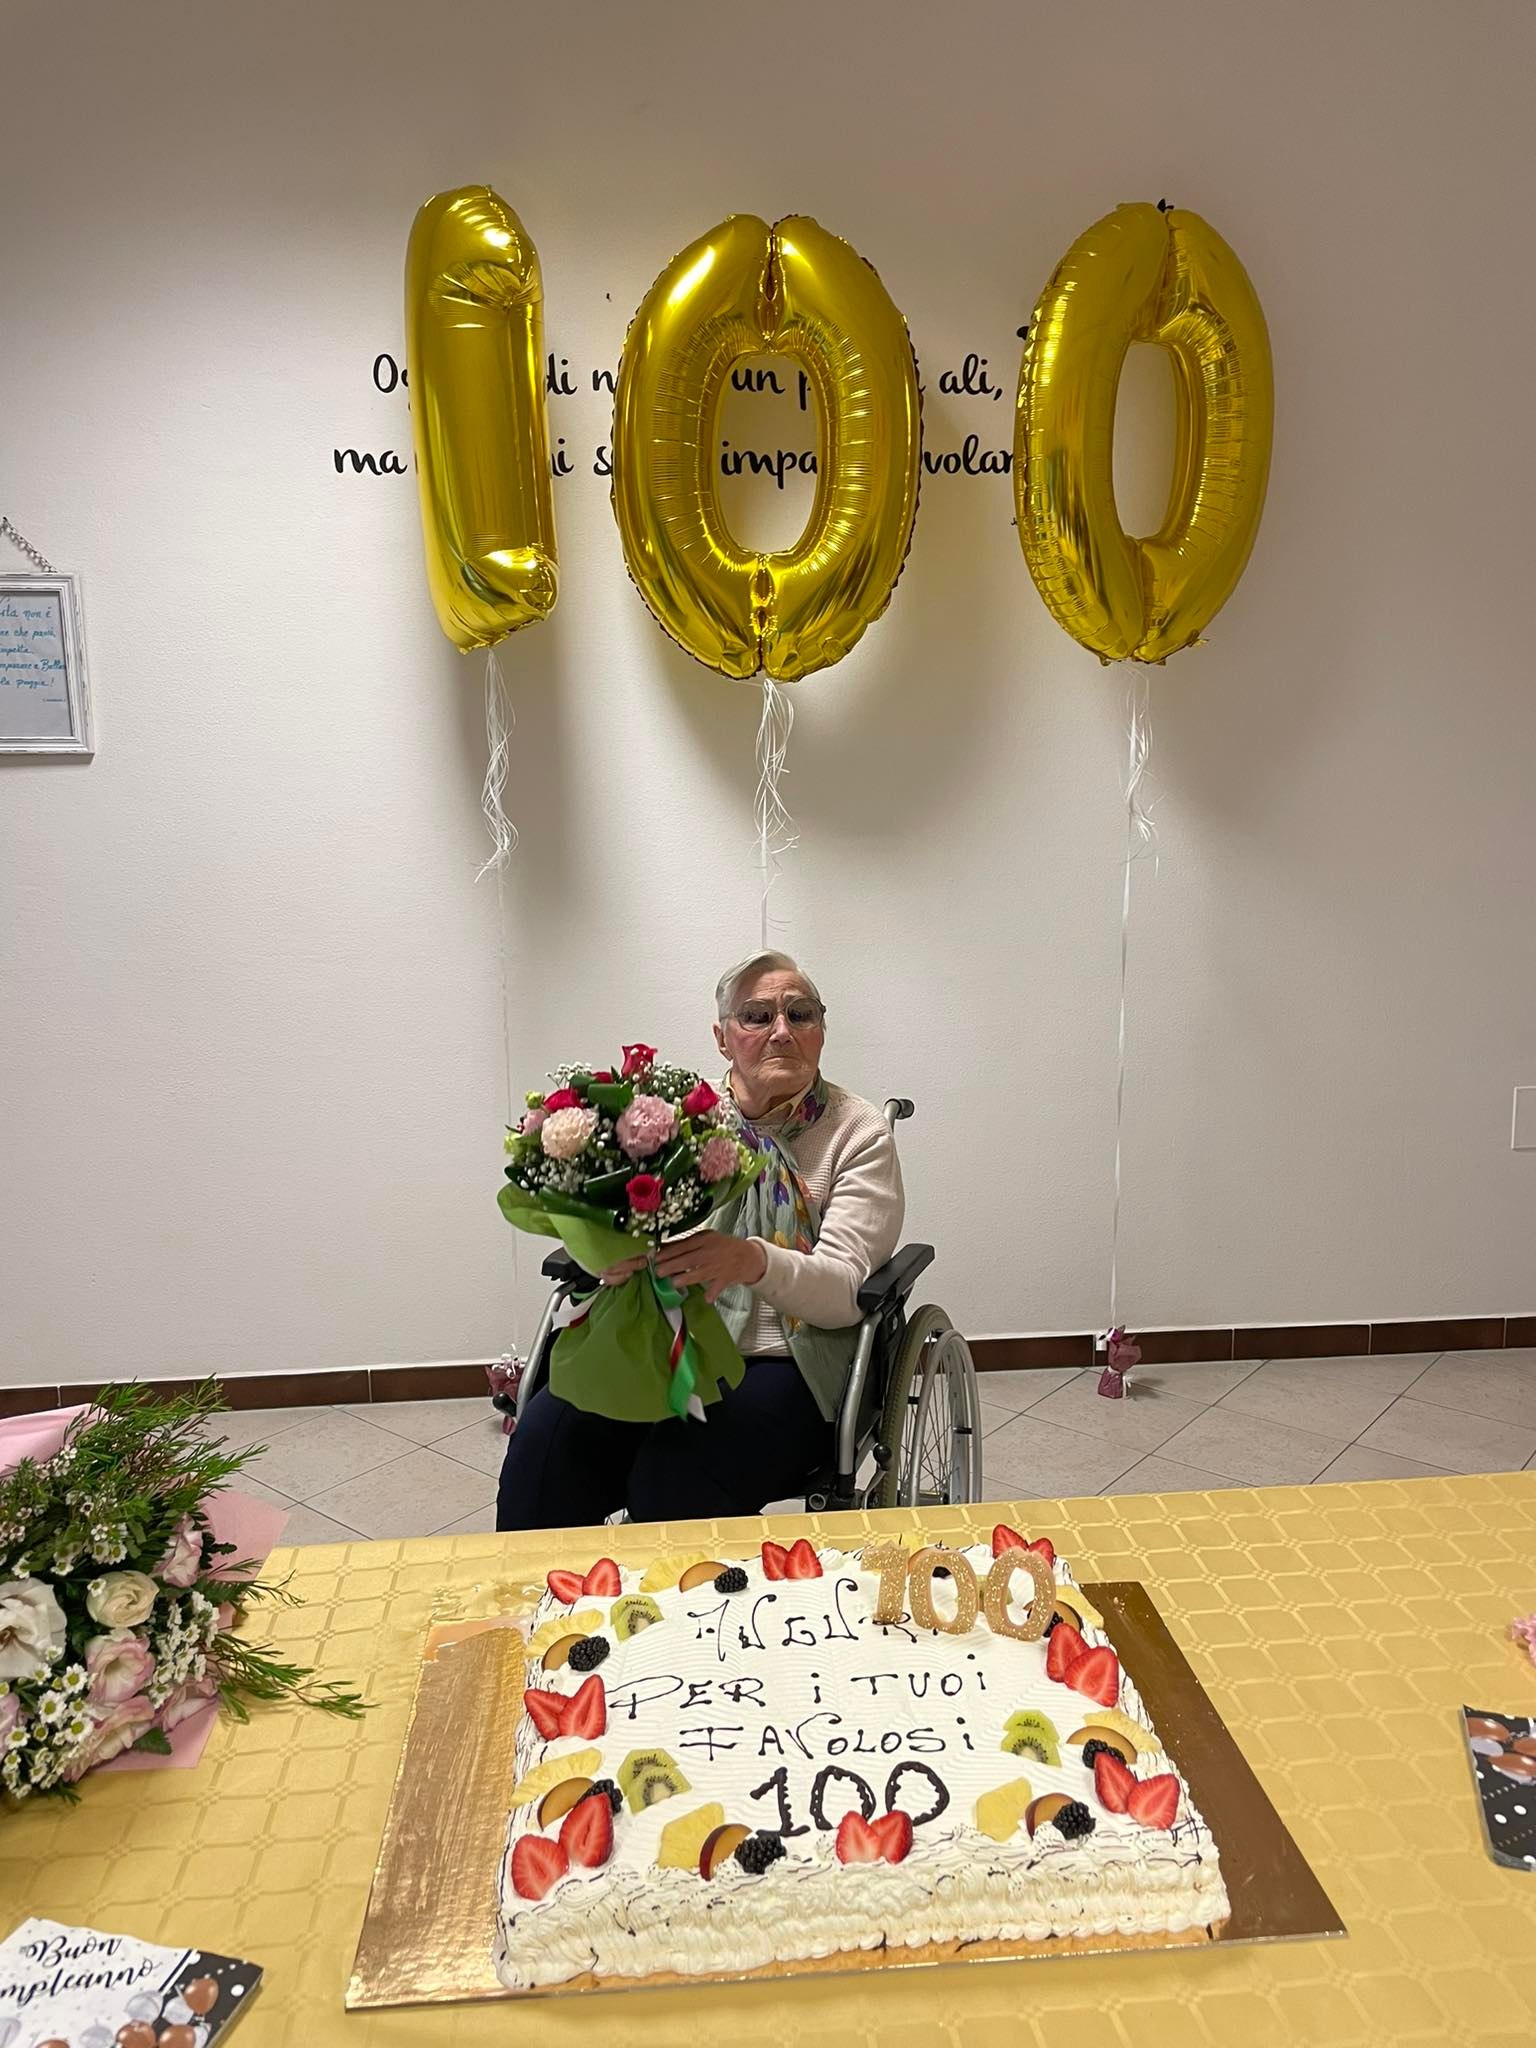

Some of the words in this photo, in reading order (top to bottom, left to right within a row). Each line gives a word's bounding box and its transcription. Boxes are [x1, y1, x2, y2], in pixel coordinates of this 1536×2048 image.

[731, 368, 786, 394] un
[938, 353, 1004, 401] ali,
[334, 448, 409, 476] ma
[721, 440, 819, 490] impa
[923, 433, 1014, 476] volar
[861, 1539, 1057, 1643] 100
[603, 1674, 767, 1719] PER
[749, 1760, 951, 1838] 100
[24, 1935, 122, 1968] Buon
[0, 1958, 162, 2008] mpleanno
